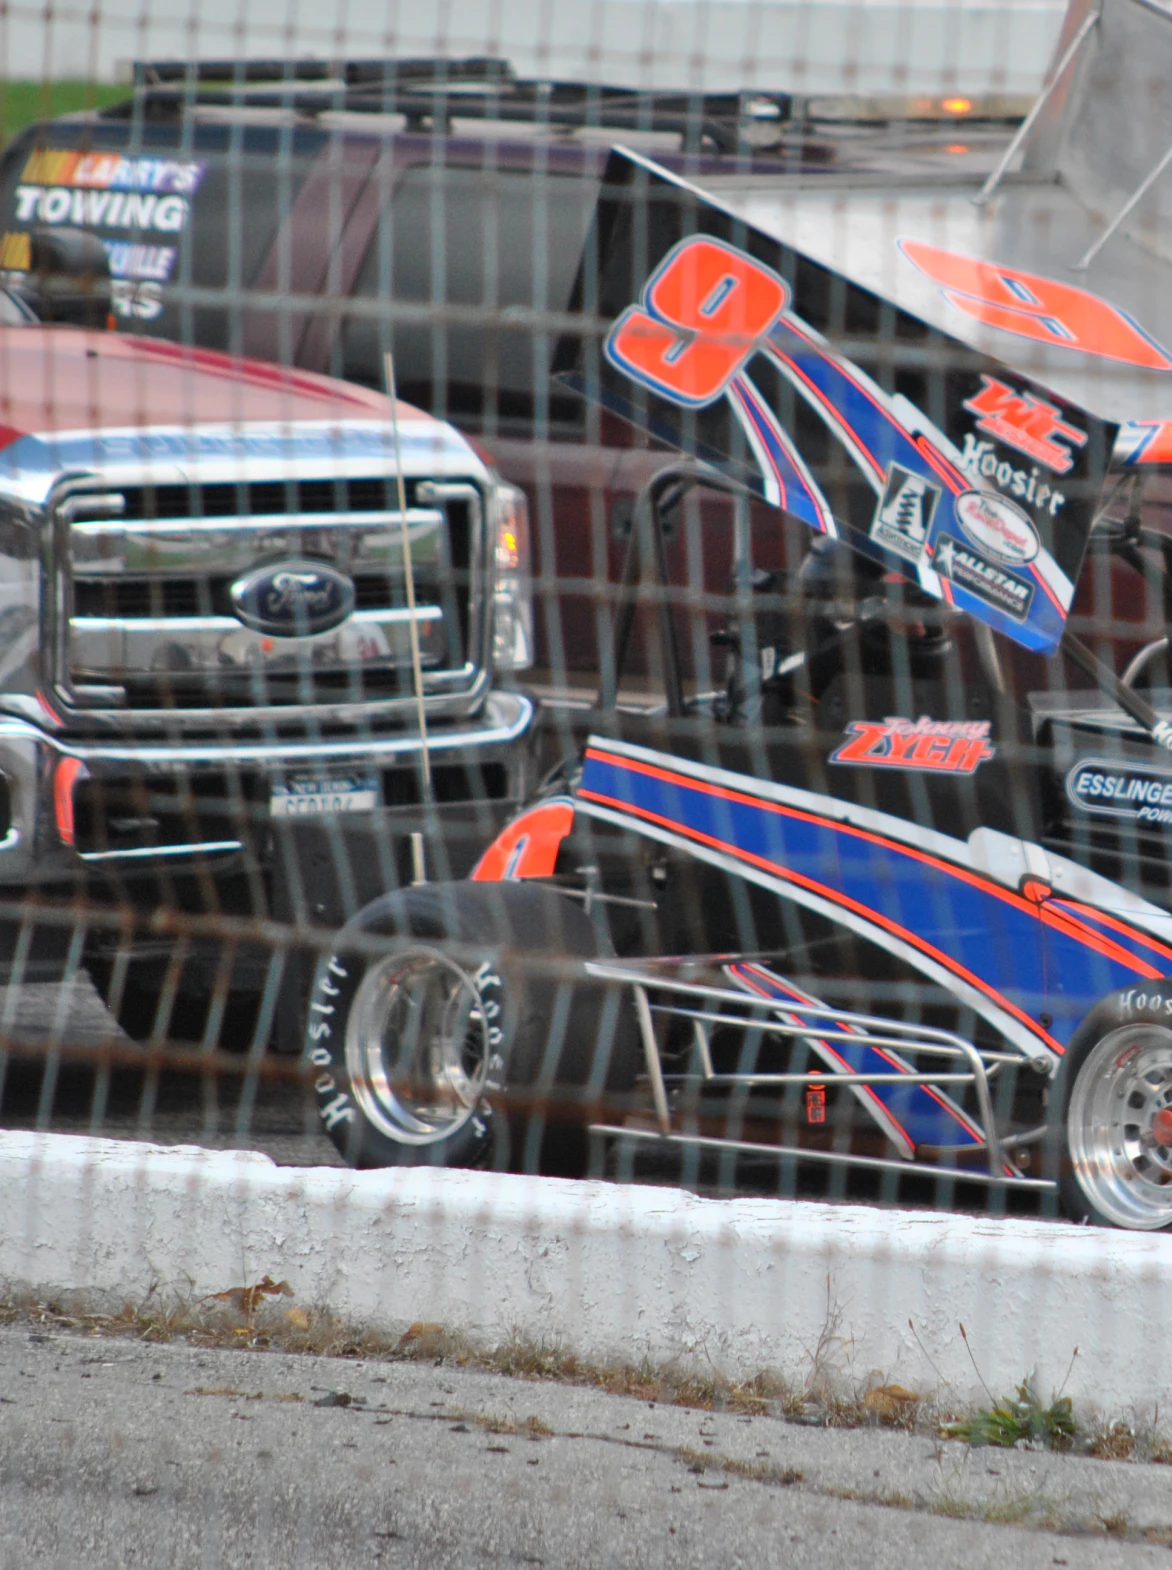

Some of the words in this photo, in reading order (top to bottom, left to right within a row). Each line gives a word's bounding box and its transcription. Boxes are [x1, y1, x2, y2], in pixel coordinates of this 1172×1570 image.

[73, 158, 199, 190] LARRY'S
[16, 186, 188, 231] TOWING
[603, 233, 792, 410] 9
[960, 433, 1065, 515] Hoosier
[266, 571, 334, 613] Ford
[953, 565, 1025, 611] PERFORMANCE
[954, 550, 1030, 599] ALLSTAR
[830, 721, 995, 776] ZYCH
[309, 955, 357, 1131] Hoosier
